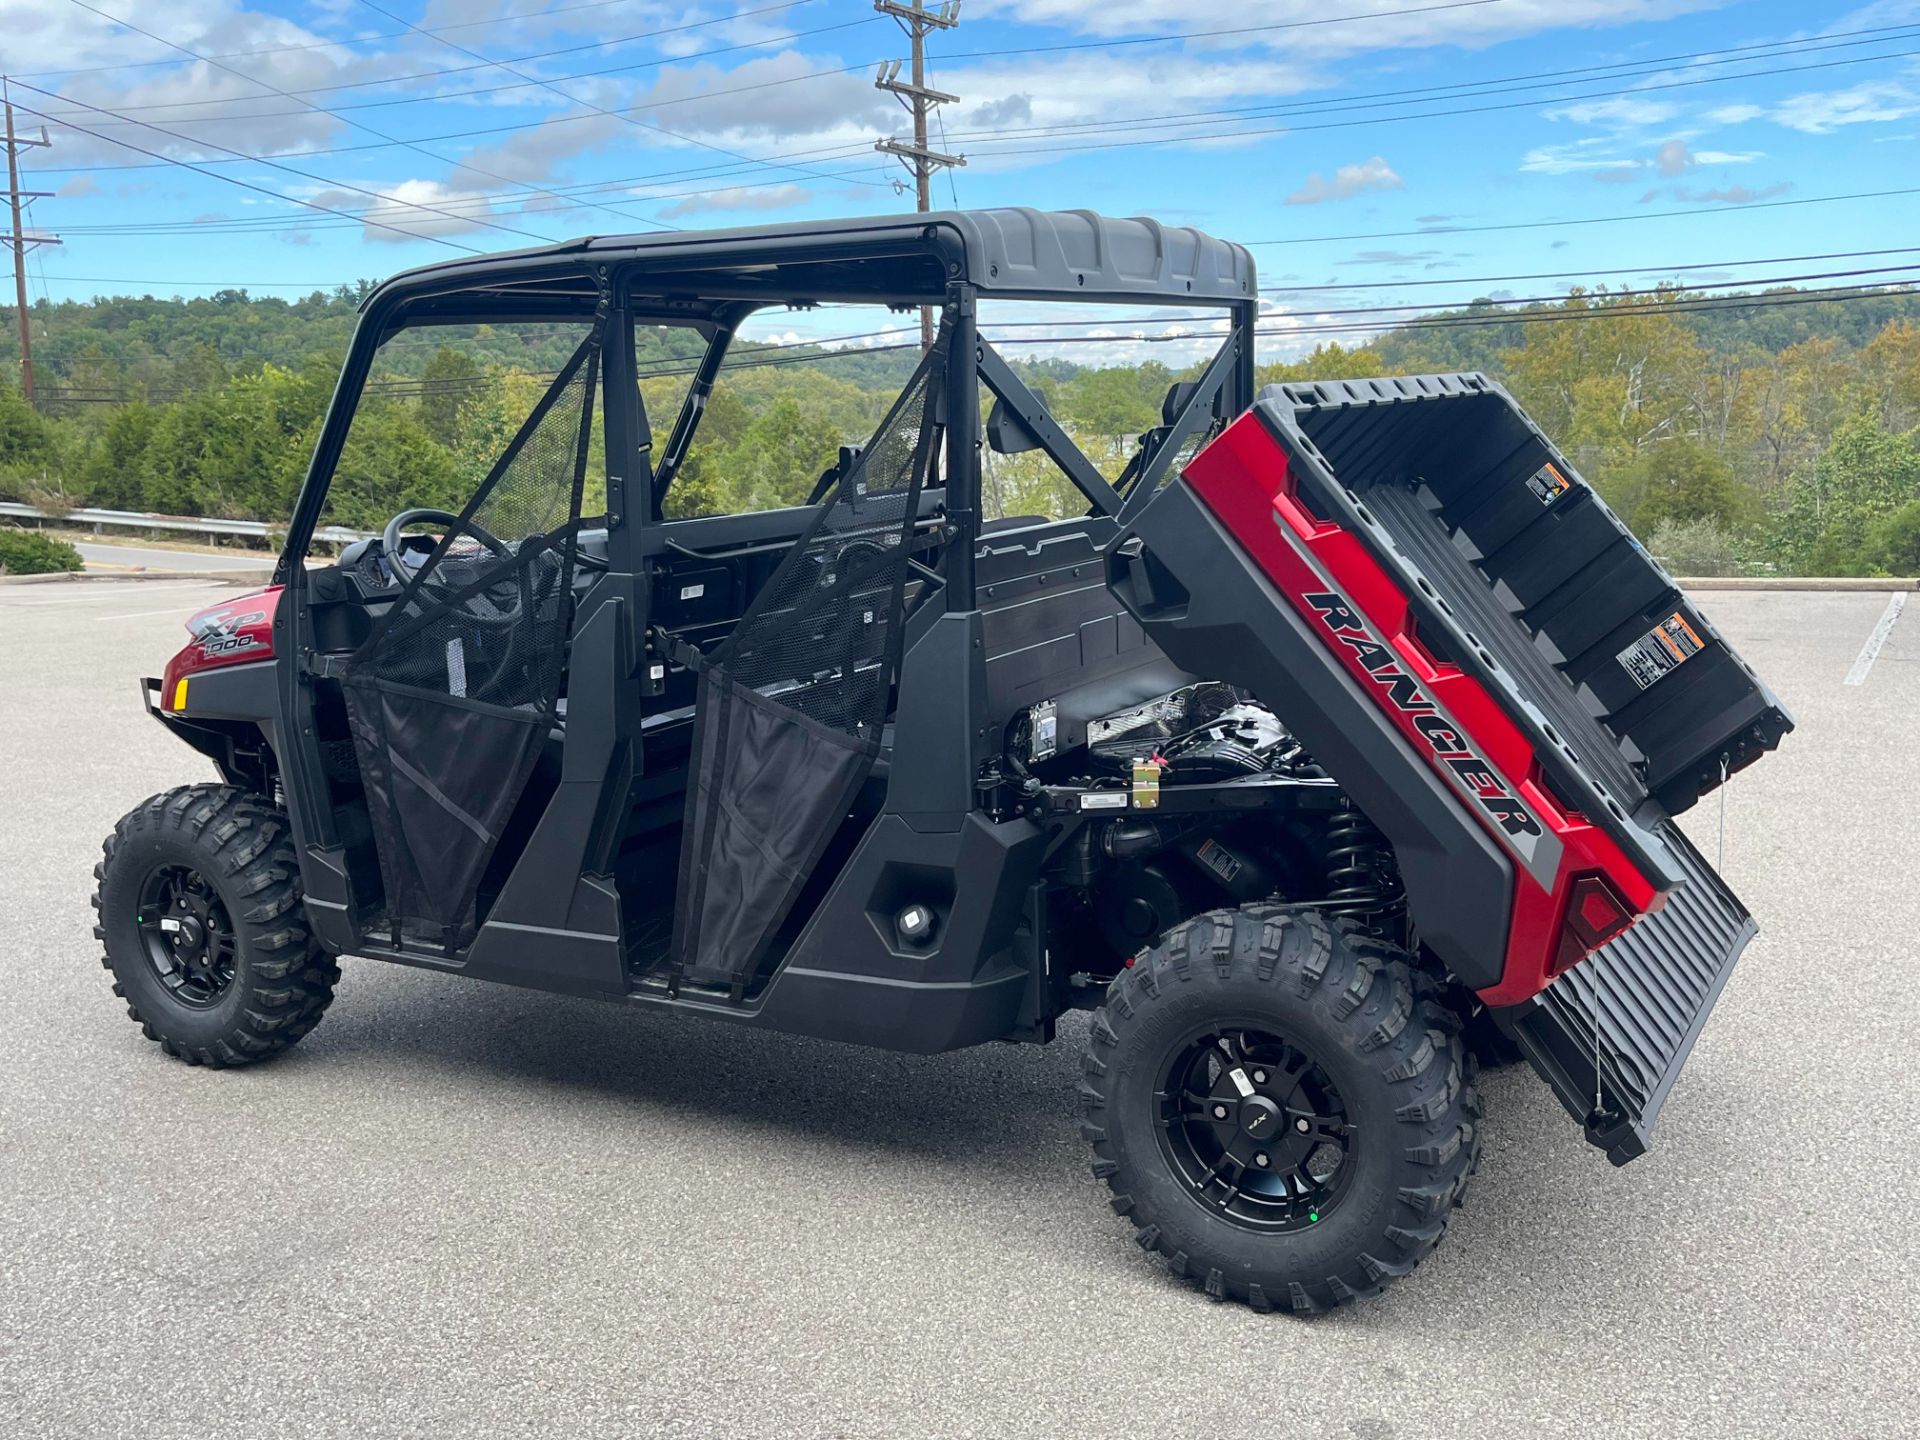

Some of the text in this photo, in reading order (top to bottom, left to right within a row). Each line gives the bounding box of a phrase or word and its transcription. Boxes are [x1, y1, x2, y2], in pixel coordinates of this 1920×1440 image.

[192, 610, 267, 646] XP
[204, 634, 254, 655] 1000
[1302, 592, 1543, 838] RANGER
